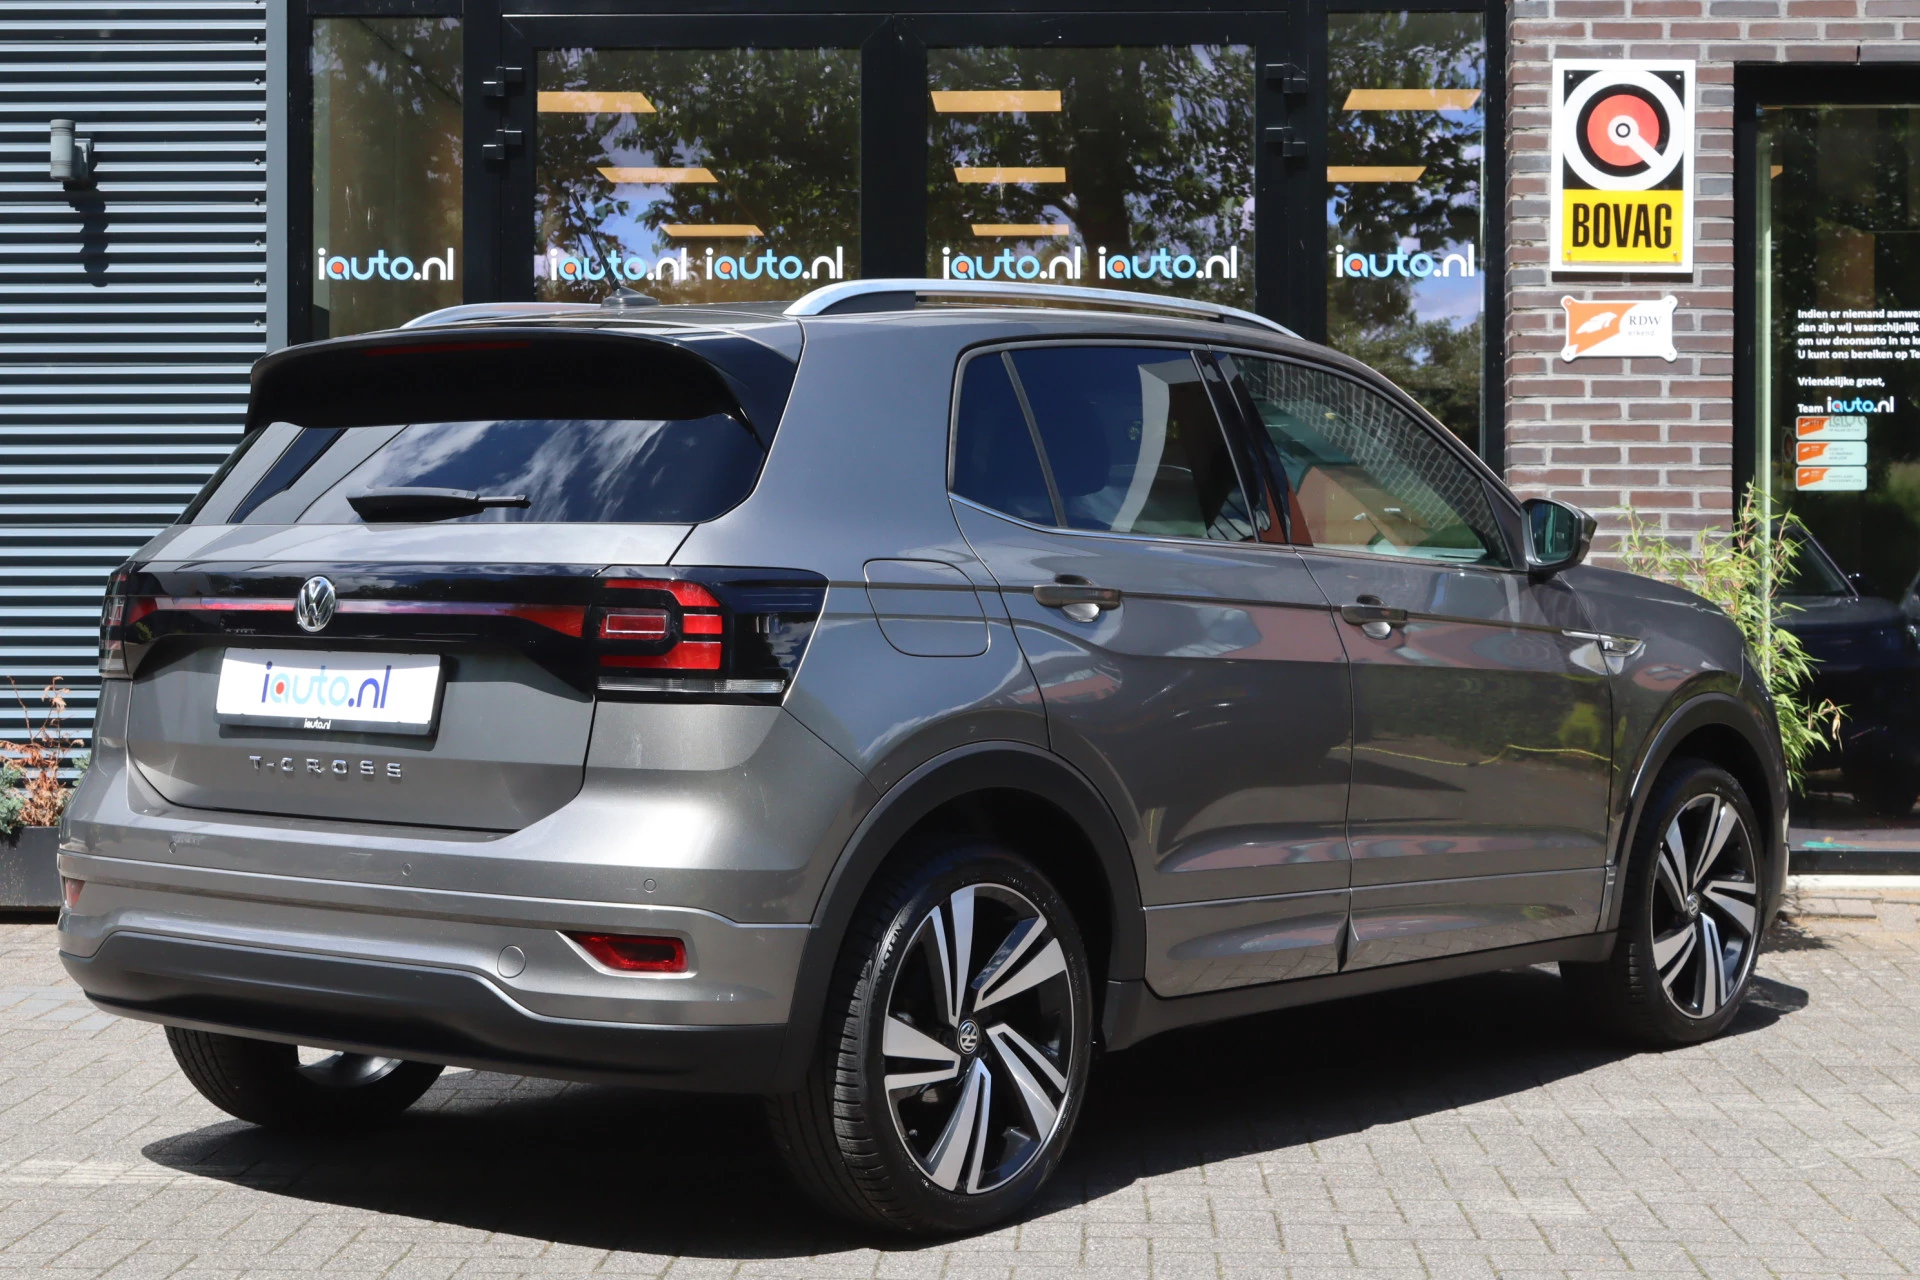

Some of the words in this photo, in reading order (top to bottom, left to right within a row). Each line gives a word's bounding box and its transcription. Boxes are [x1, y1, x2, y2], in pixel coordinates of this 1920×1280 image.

[1572, 202, 1672, 249] BOVAG
[318, 248, 454, 280] iauto.nl
[550, 248, 687, 281] iauto.nl
[706, 246, 843, 280] iauto.nl
[942, 246, 1081, 280] iauto.nl
[1099, 246, 1237, 279] iauto.nl
[1336, 244, 1475, 277] iauto.nl
[1629, 315, 1662, 325] RDW
[1798, 309, 1828, 319] Indien
[1830, 311, 1841, 319] er
[1842, 309, 1885, 319] niemand
[1798, 322, 1816, 332] dan
[1818, 322, 1835, 333] zijn
[1837, 322, 1852, 333] wij
[1854, 322, 1919, 333] waarschijnlijk
[1798, 337, 1813, 345] om
[1816, 337, 1831, 345] uw
[1833, 336, 1886, 345] droomauto
[1889, 336, 1898, 345] in
[1900, 336, 1910, 345] te
[1798, 350, 1806, 359] U
[1808, 350, 1829, 359] kunt
[1831, 351, 1849, 359] ons
[1851, 349, 1893, 359] bereiken
[1895, 351, 1908, 360] op
[1798, 376, 1854, 387] Vriendelijke
[1856, 377, 1885, 387] groet,
[1798, 404, 1823, 413] Team
[1827, 396, 1894, 413] iauto.nl
[261, 661, 392, 709] iauto.nl
[304, 718, 331, 730] iauto.nl
[249, 755, 402, 778] T-CROSS
